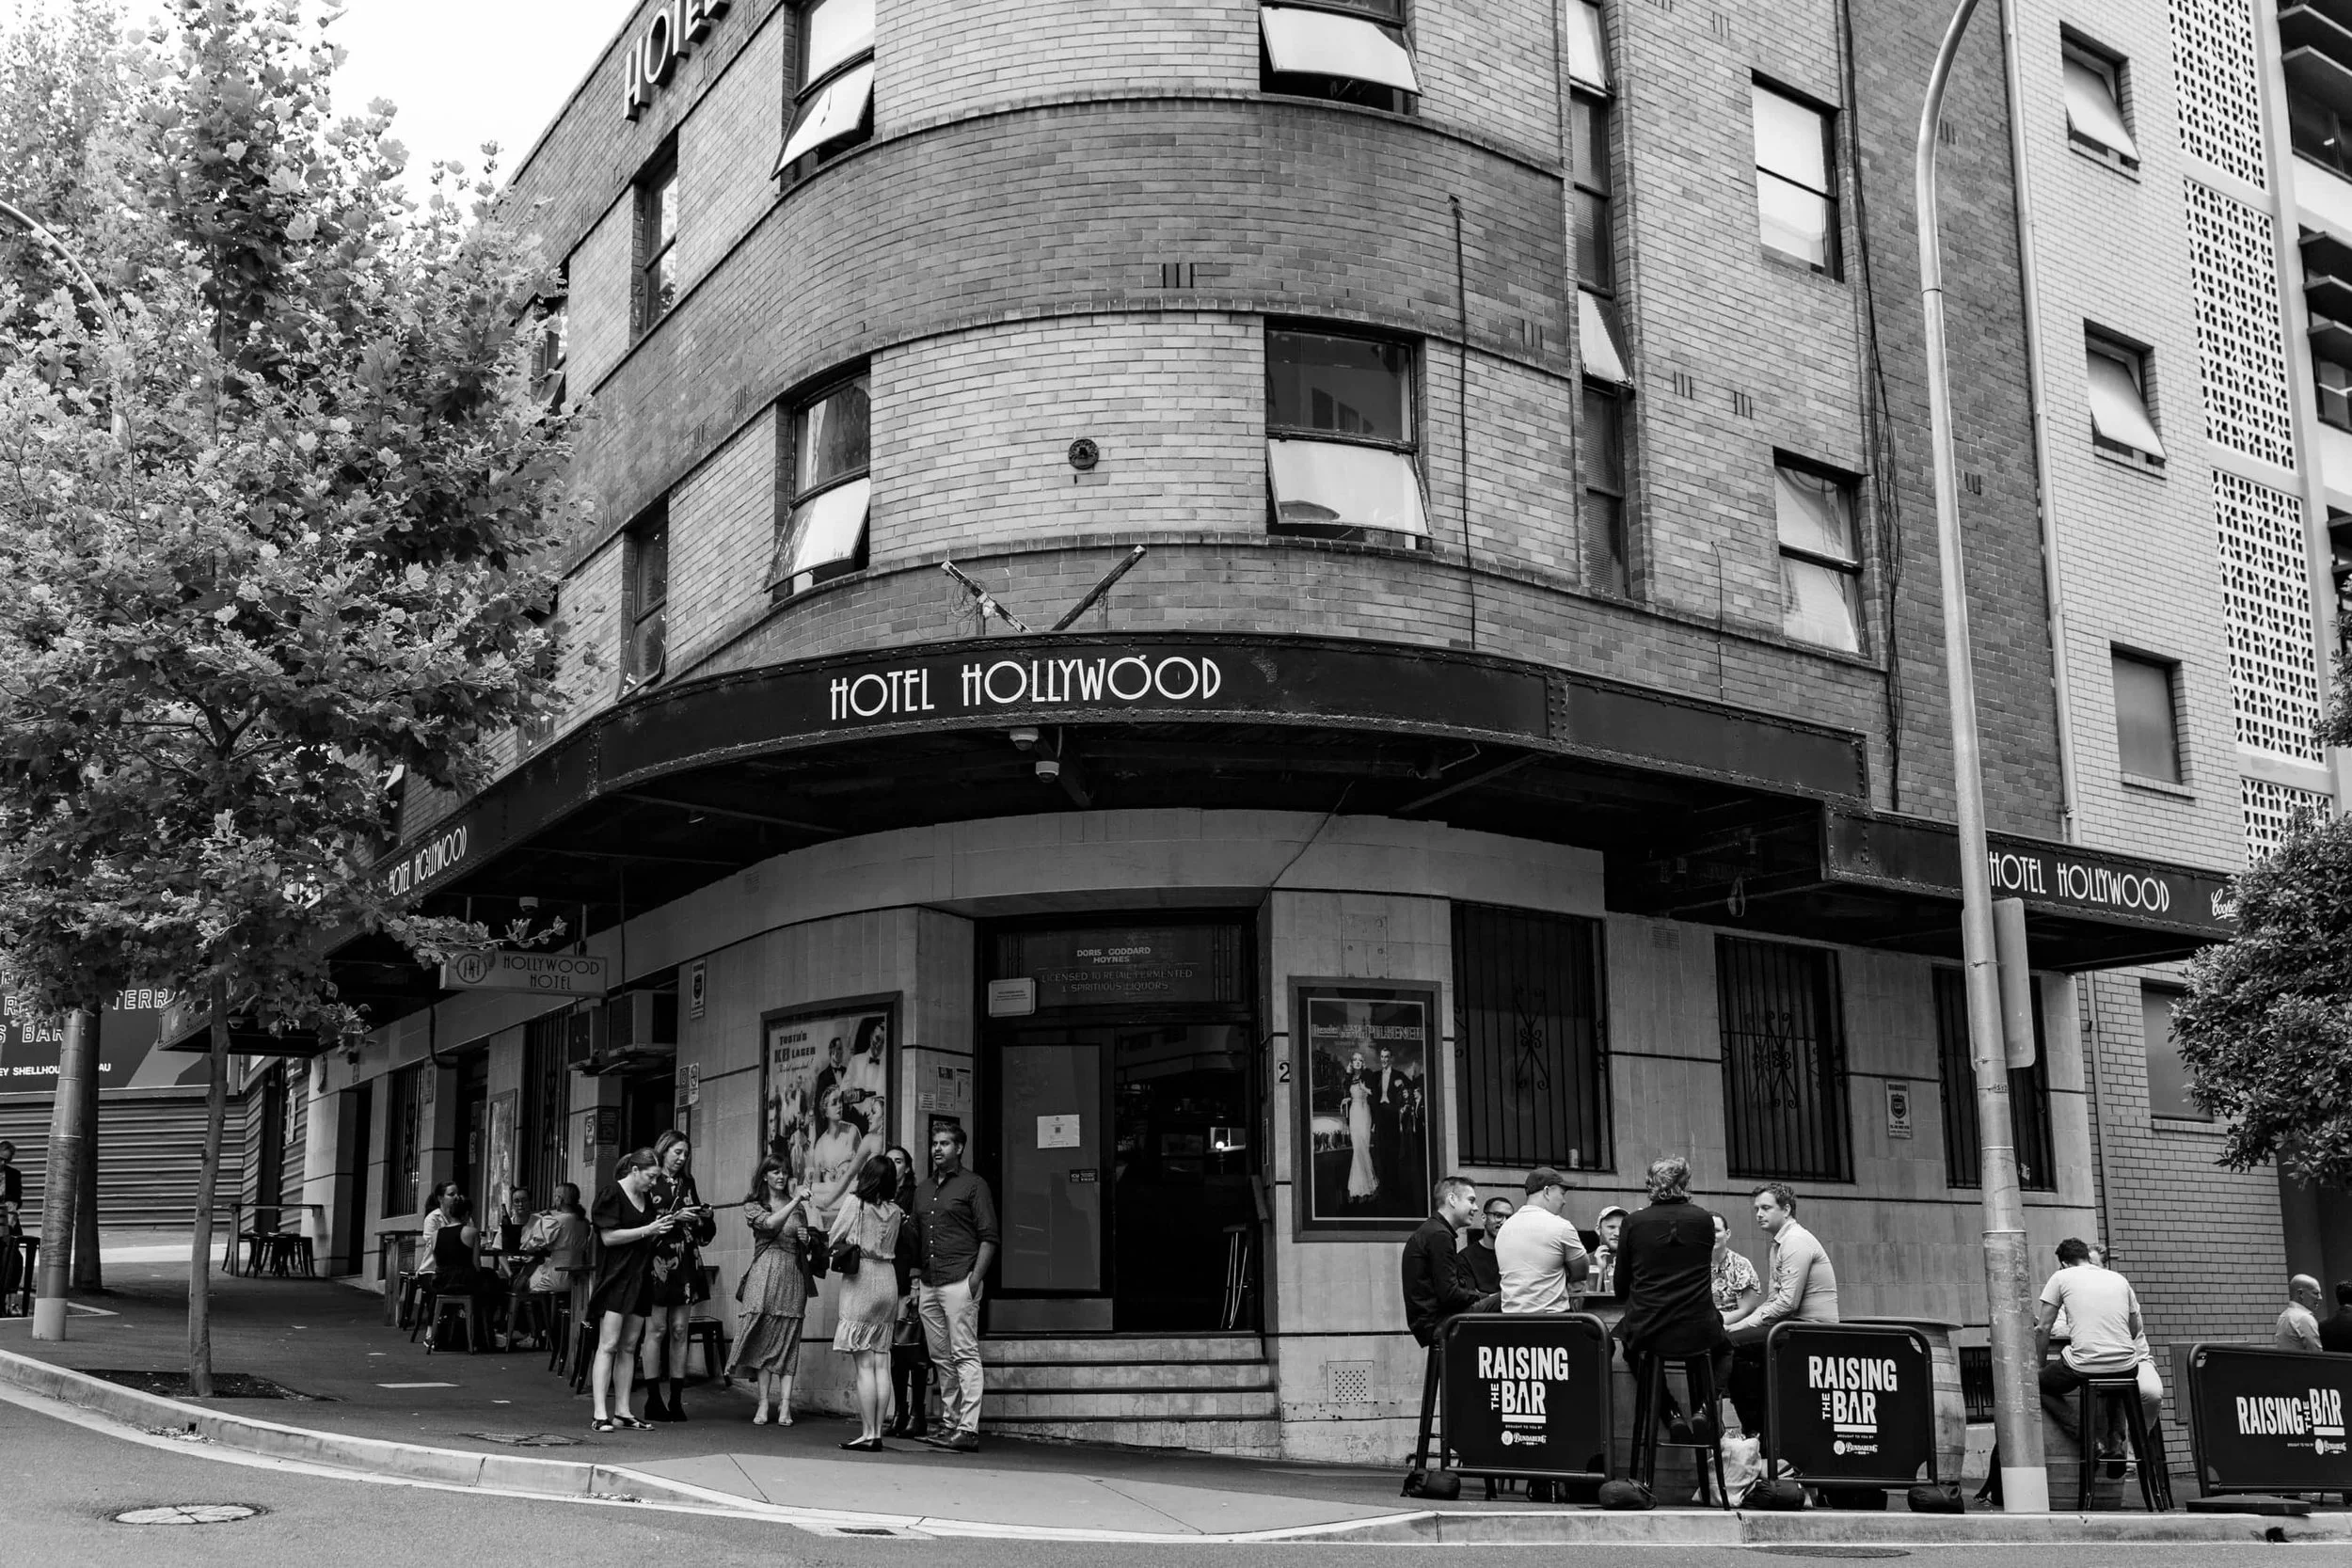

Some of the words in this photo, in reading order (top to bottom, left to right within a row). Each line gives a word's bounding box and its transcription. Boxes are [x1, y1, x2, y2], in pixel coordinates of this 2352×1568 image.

[831, 668, 934, 721] HOTEL
[961, 656, 1221, 706] HOLLYWOOD
[389, 860, 410, 895] HOTEL
[414, 825, 468, 885] HOLLYWOOD
[1989, 851, 2046, 894] HOTEL
[2057, 863, 2169, 911] HOLLYWOOD
[503, 955, 599, 975] HOLLYWOOD
[1076, 948, 1102, 958] DORIS
[1107, 946, 1151, 956] GODDARD
[1093, 955, 1130, 964] HOYNES
[530, 974, 572, 990] HOTEL
[1041, 972, 1088, 983] LICENSED
[1279, 1062, 1290, 1083] 2
[1478, 1346, 1568, 1381] RAISING
[1808, 1355, 1898, 1391] RAISING
[1490, 1383, 1499, 1410] THE
[1502, 1381, 1546, 1414] BAR
[1821, 1392, 1831, 1419] THE
[1833, 1390, 1877, 1424] BAR
[2303, 1401, 2312, 1432] THE
[2309, 1388, 2344, 1426] BAR
[2235, 1396, 2305, 1434] RAISING
